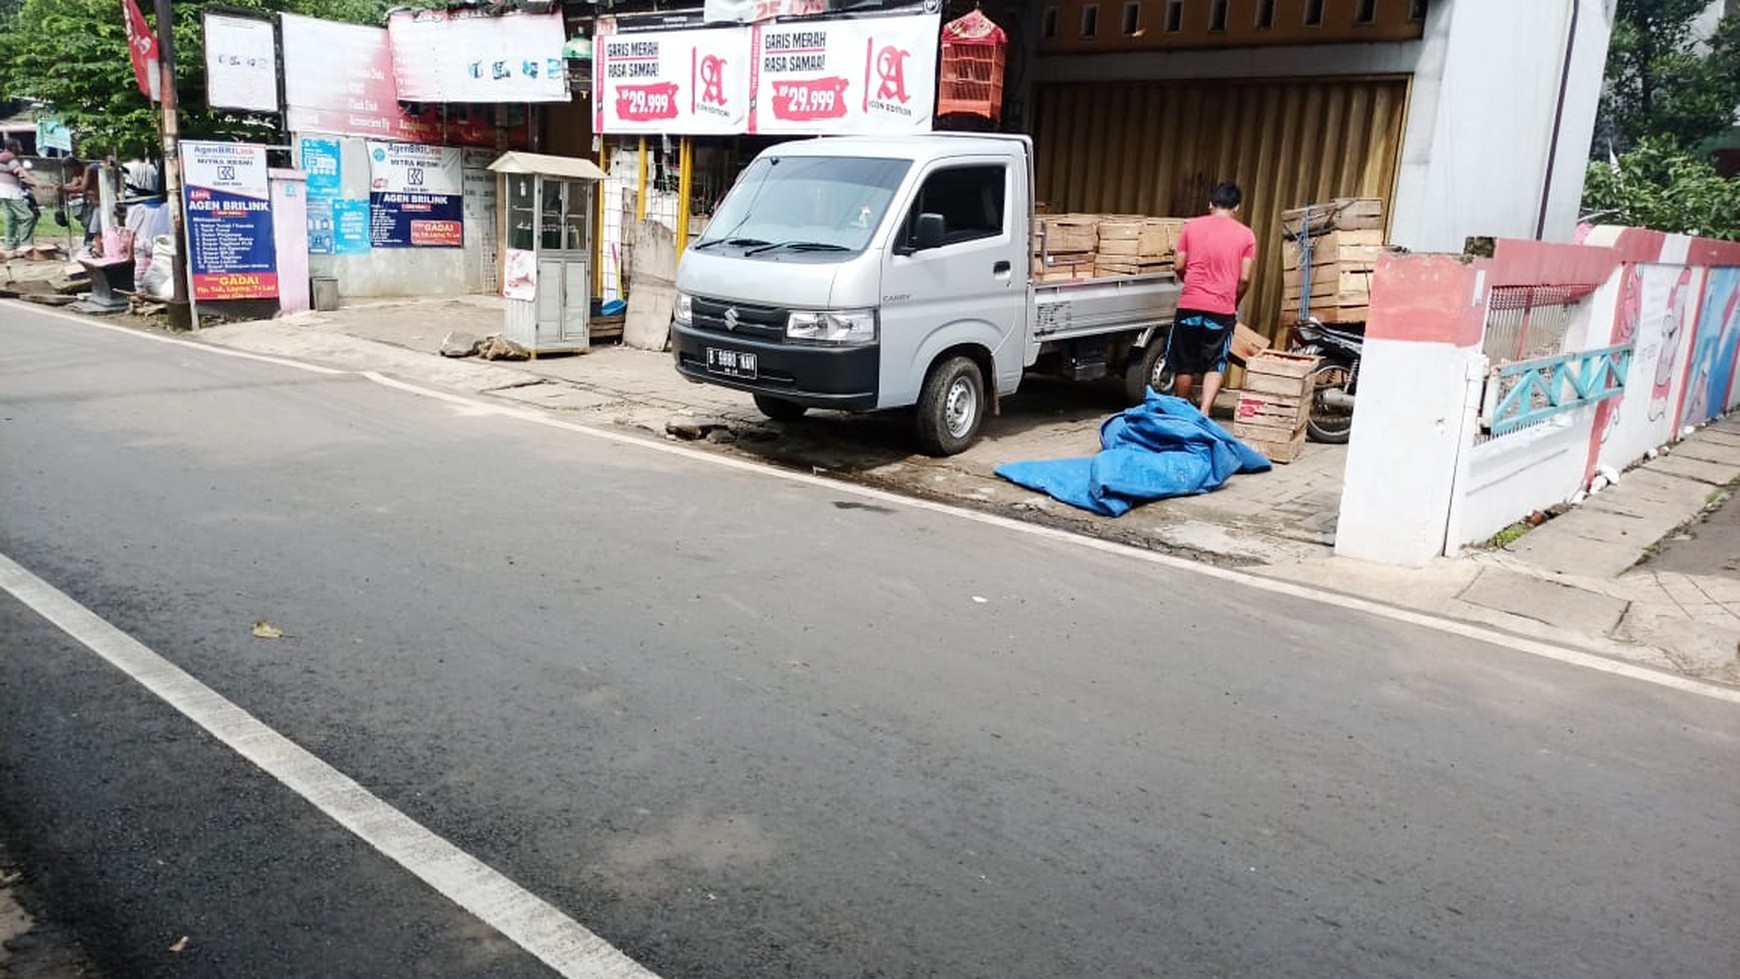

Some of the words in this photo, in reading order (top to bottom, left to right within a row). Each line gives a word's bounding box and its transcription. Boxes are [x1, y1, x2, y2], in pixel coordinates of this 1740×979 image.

[766, 33, 790, 49] GARIS
[793, 32, 826, 48] MERAH
[607, 43, 629, 57] GARIS
[631, 41, 659, 56] MERAH
[608, 64, 627, 77] RASA
[764, 56, 787, 72] RASA
[189, 200, 221, 211] AGEN
[223, 200, 269, 212] BRILINK
[384, 193, 410, 203] AGEN
[411, 194, 448, 205] BRILINK
